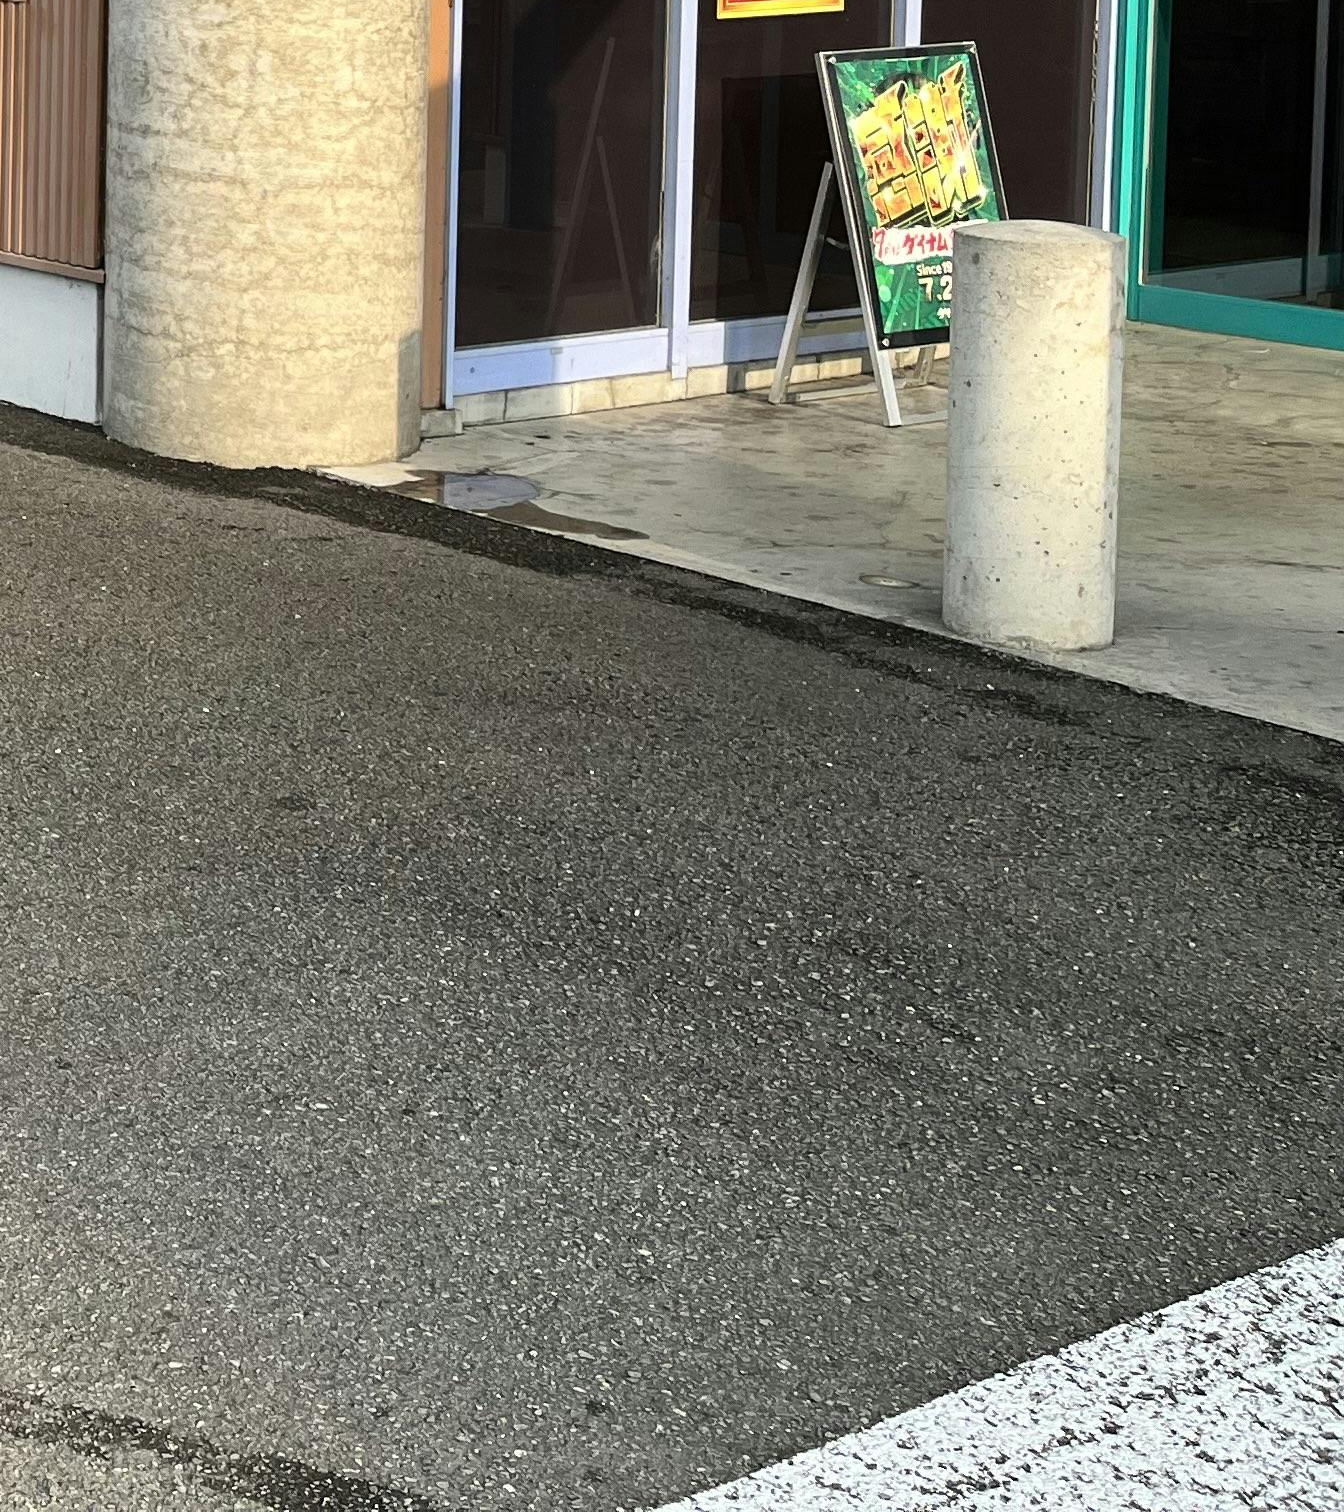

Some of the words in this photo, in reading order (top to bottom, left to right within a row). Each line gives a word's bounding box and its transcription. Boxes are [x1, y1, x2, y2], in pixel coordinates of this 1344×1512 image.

[916, 263, 943, 276] Since
[942, 260, 953, 275] 19
[918, 275, 953, 302] 7.2
